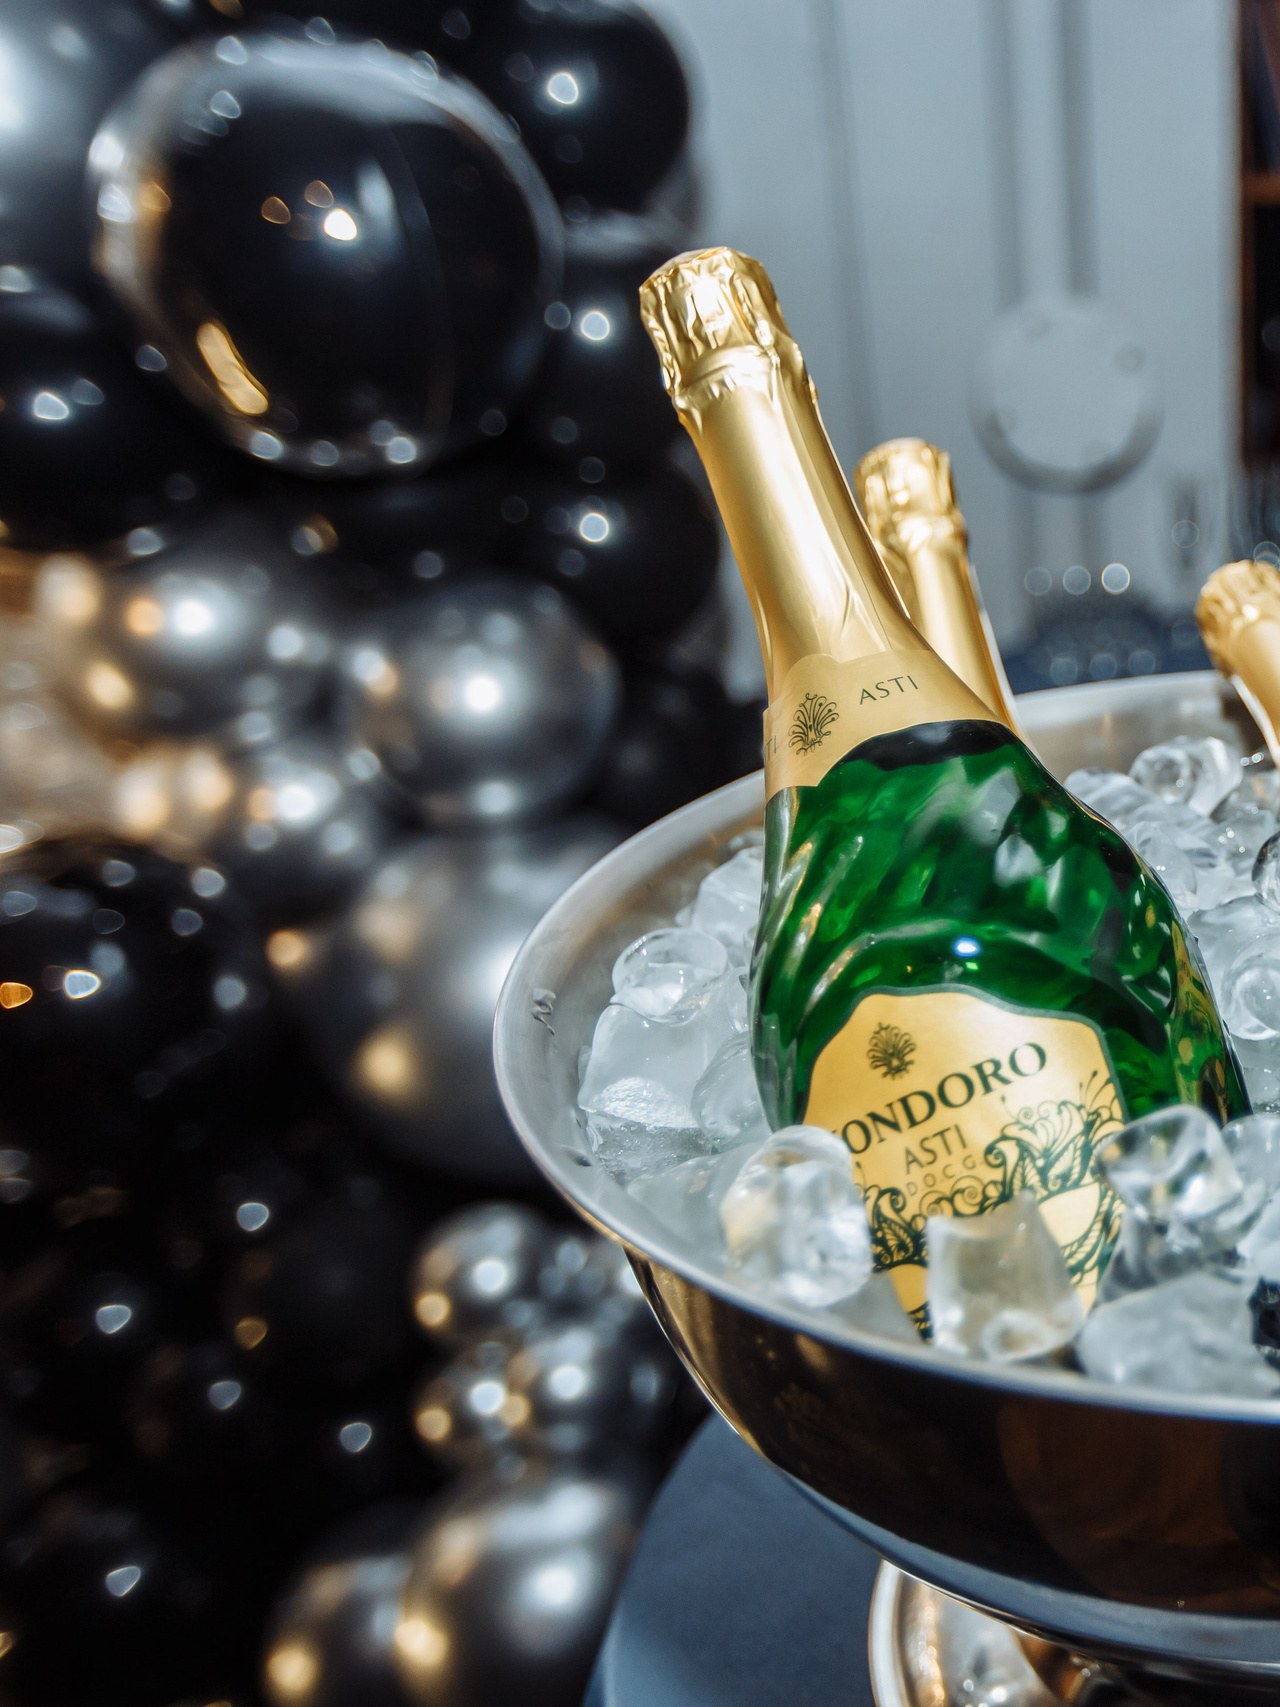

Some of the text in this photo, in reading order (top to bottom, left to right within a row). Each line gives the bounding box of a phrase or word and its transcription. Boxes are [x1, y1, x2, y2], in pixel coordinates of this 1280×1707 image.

[858, 675, 919, 706] ASTI
[832, 1041, 1047, 1155] ONDORO
[904, 1123, 967, 1175] ASTI
